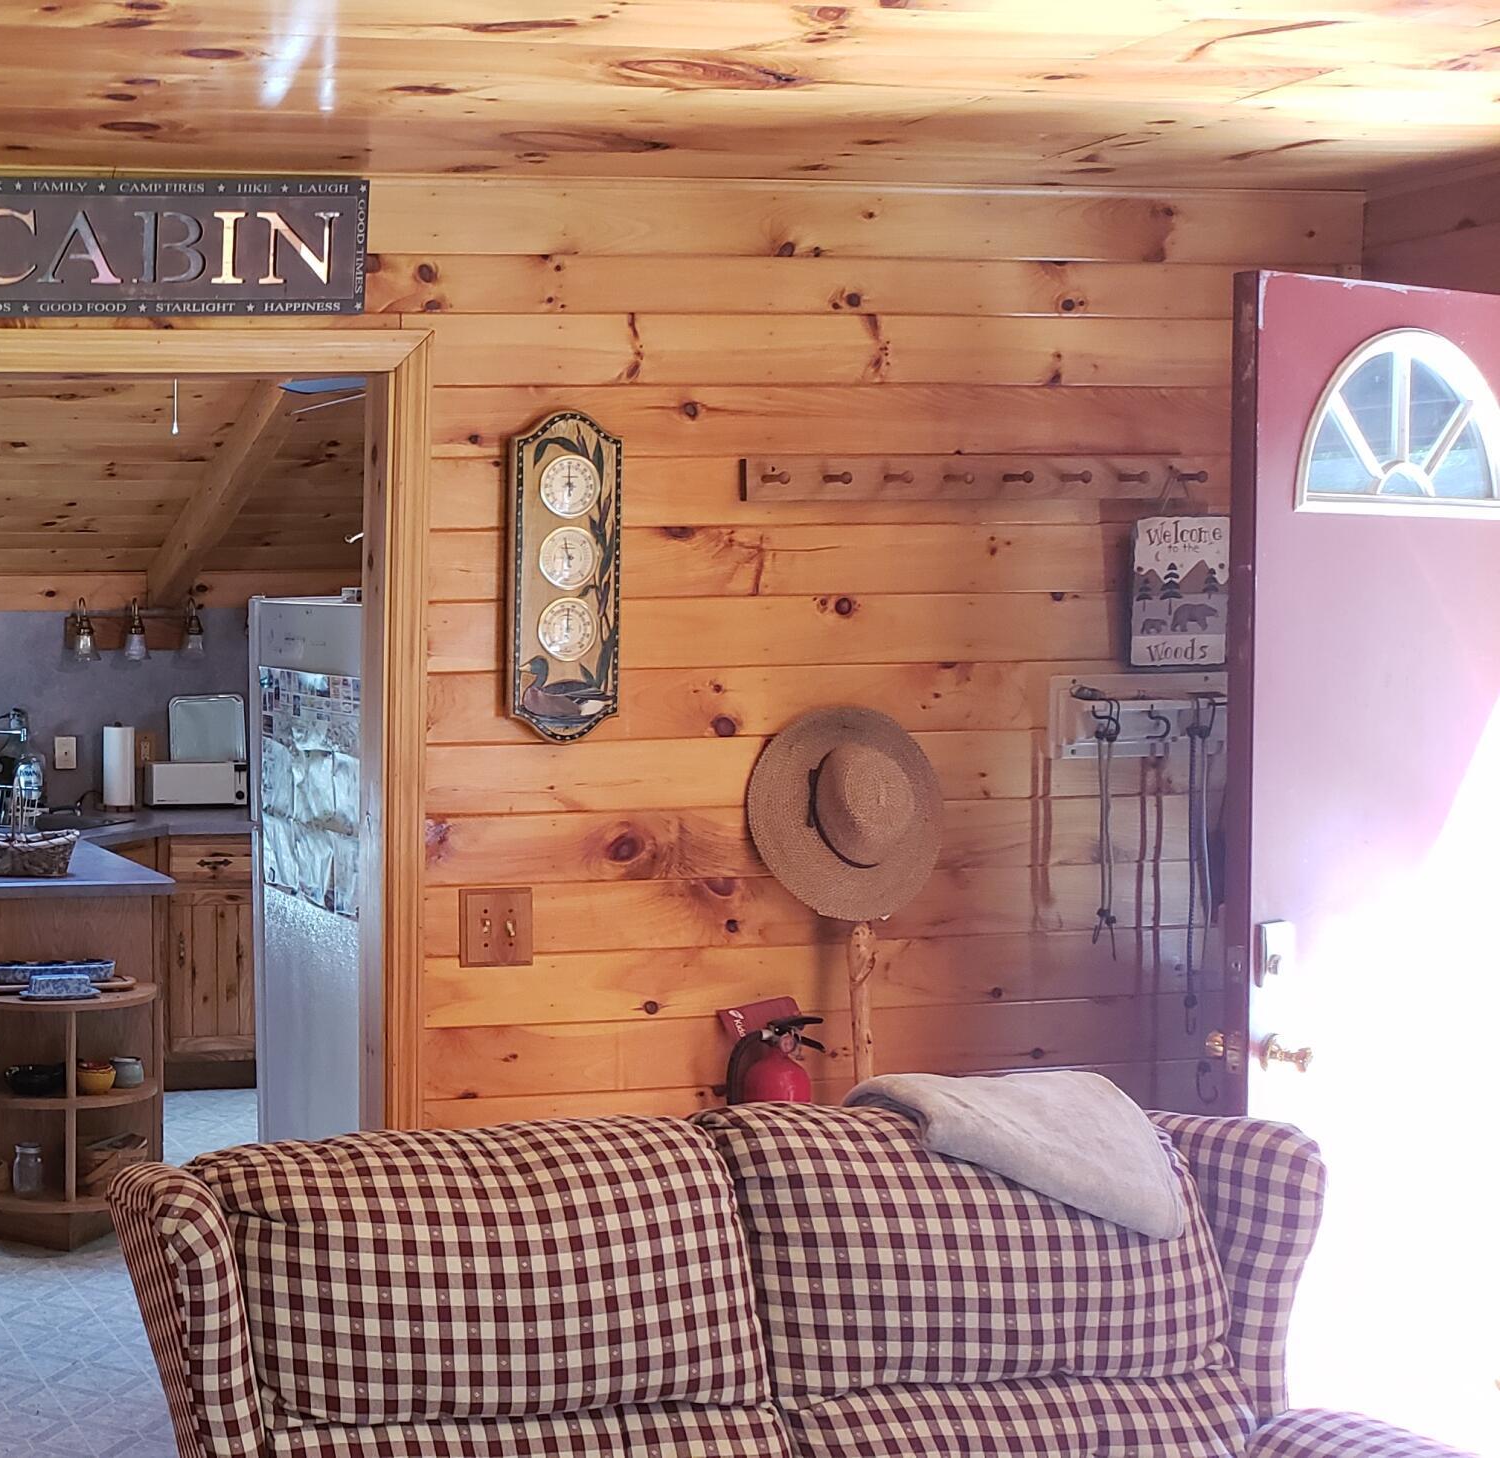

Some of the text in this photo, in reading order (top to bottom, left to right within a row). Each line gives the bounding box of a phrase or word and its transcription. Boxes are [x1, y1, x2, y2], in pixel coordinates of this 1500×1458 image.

[33, 181, 88, 192] FAMILY
[119, 182, 205, 193] CAMP FIRES
[237, 183, 273, 193] HIKE
[298, 184, 349, 194] LAUGH
[354, 199, 366, 294] GOOD TIMES
[39, 302, 127, 312] GOOD FOOD
[155, 302, 236, 312] STARLIGHT
[264, 302, 341, 312] HAPPINESS
[1146, 520, 1223, 546] Welcome
[1168, 543, 1200, 553] to the
[1146, 638, 1209, 662] Woods
